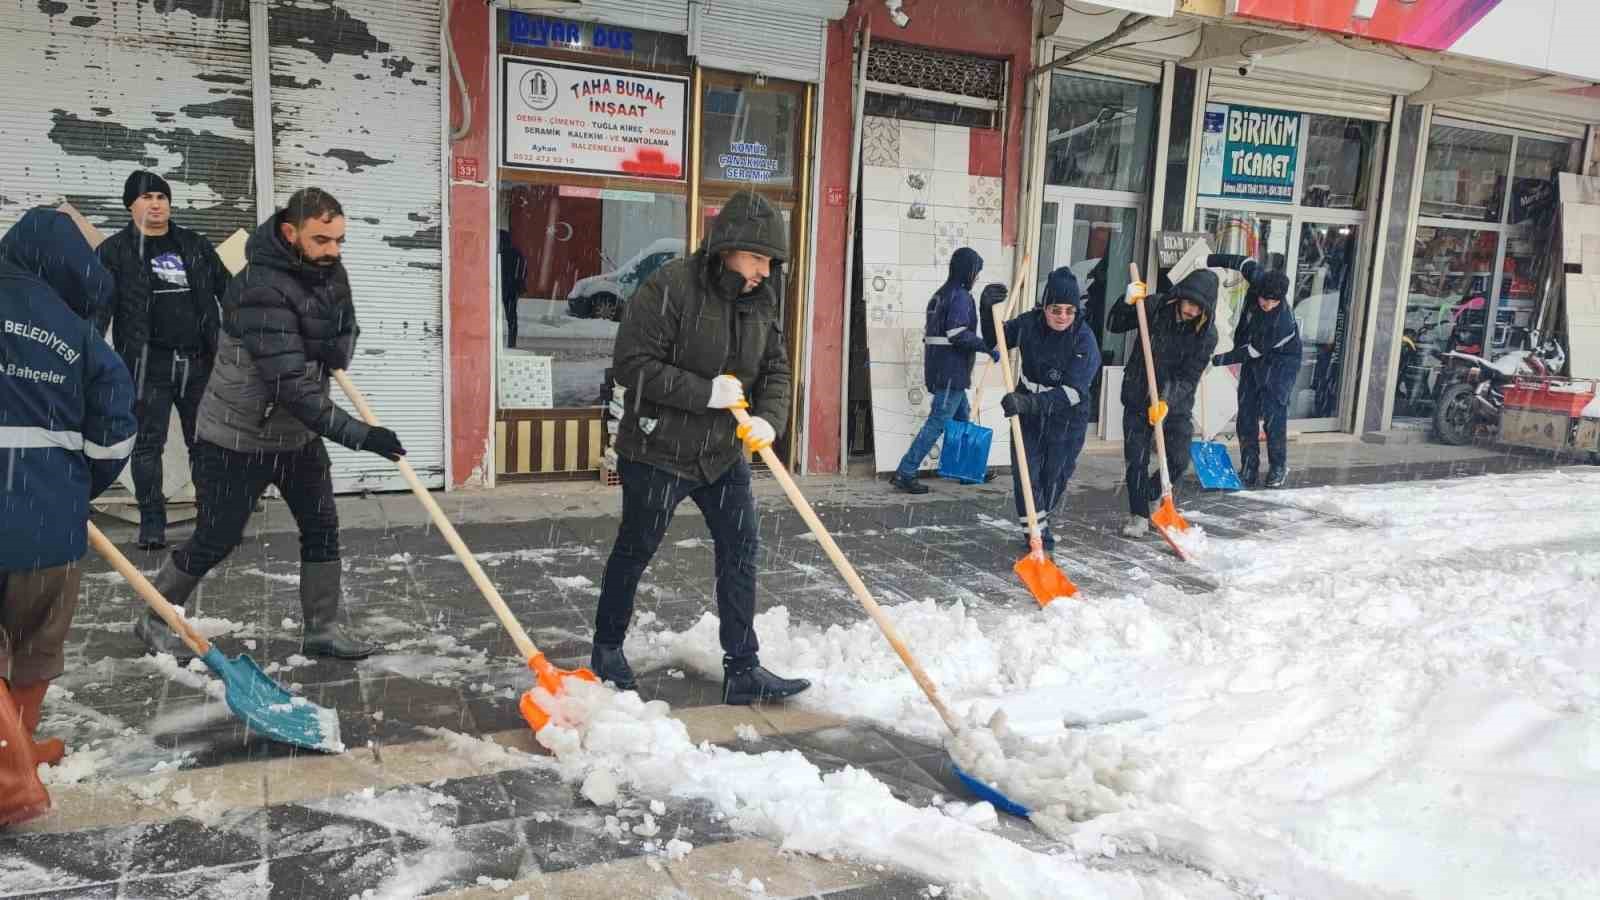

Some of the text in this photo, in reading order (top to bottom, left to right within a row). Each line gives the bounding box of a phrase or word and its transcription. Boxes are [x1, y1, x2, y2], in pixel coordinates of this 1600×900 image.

[570, 78, 665, 109] TAHA BURAK
[589, 97, 647, 117] İNŞAAT
[622, 135, 670, 146] MANTOLAMA
[1229, 110, 1298, 147] BİRİKİM
[1232, 149, 1290, 178] TİCARET
[4, 320, 81, 365] BELEDİYESİ
[6, 363, 66, 384] Bahçeler
